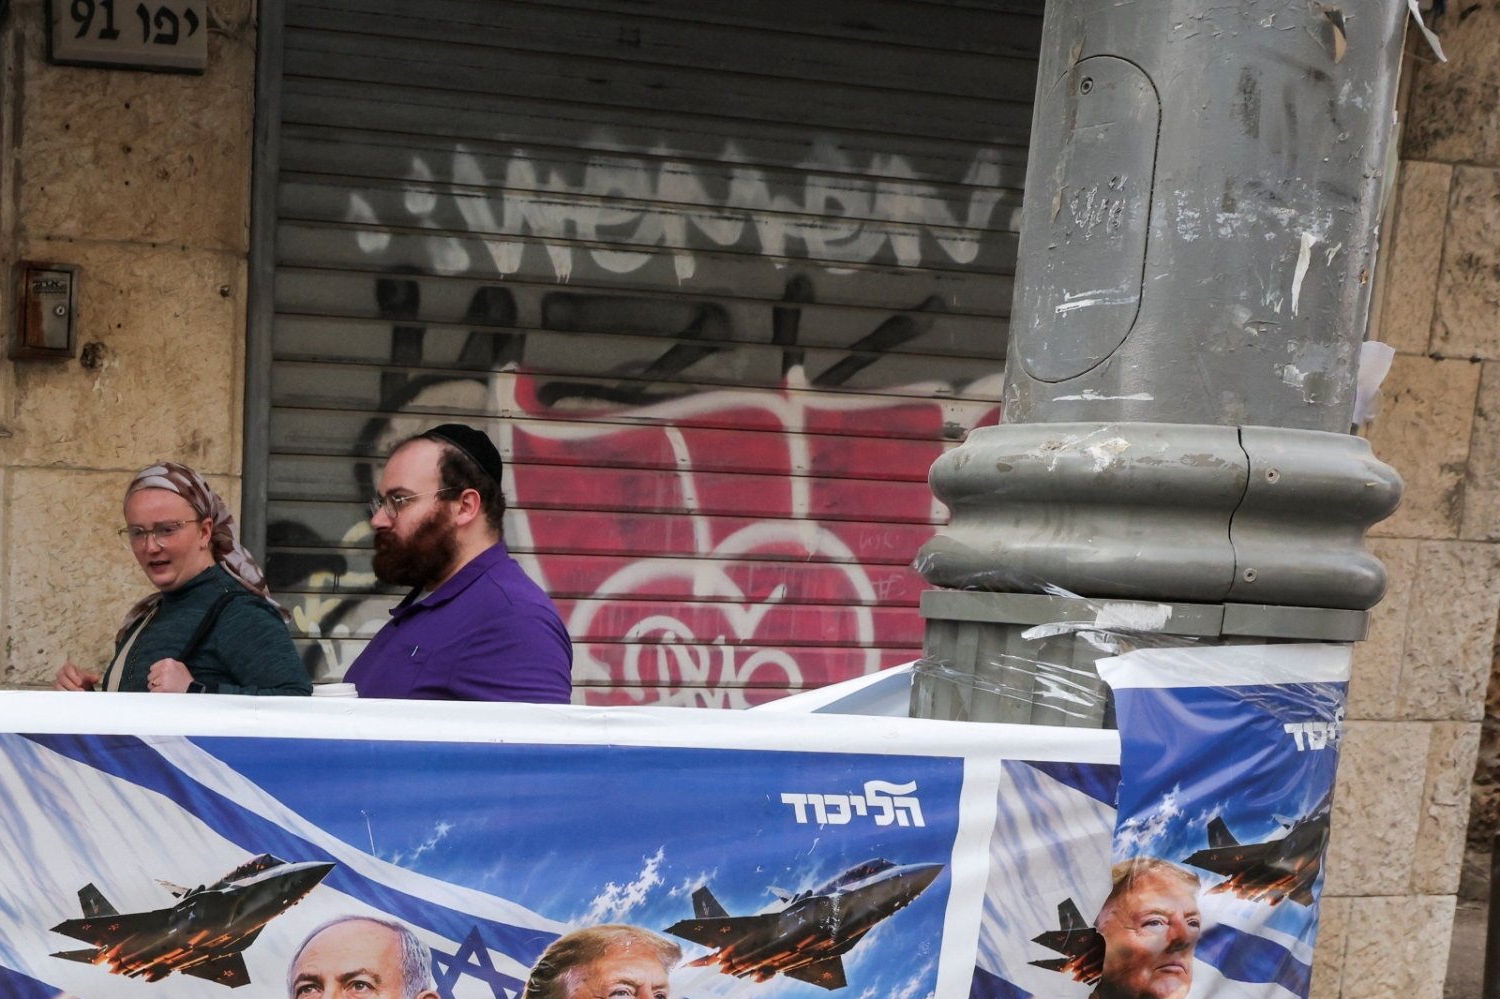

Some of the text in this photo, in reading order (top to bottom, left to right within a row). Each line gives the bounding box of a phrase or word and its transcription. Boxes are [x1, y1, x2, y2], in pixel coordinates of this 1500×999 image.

[70, 0, 199, 45] יפו 91
[781, 780, 926, 827] הליכוד
